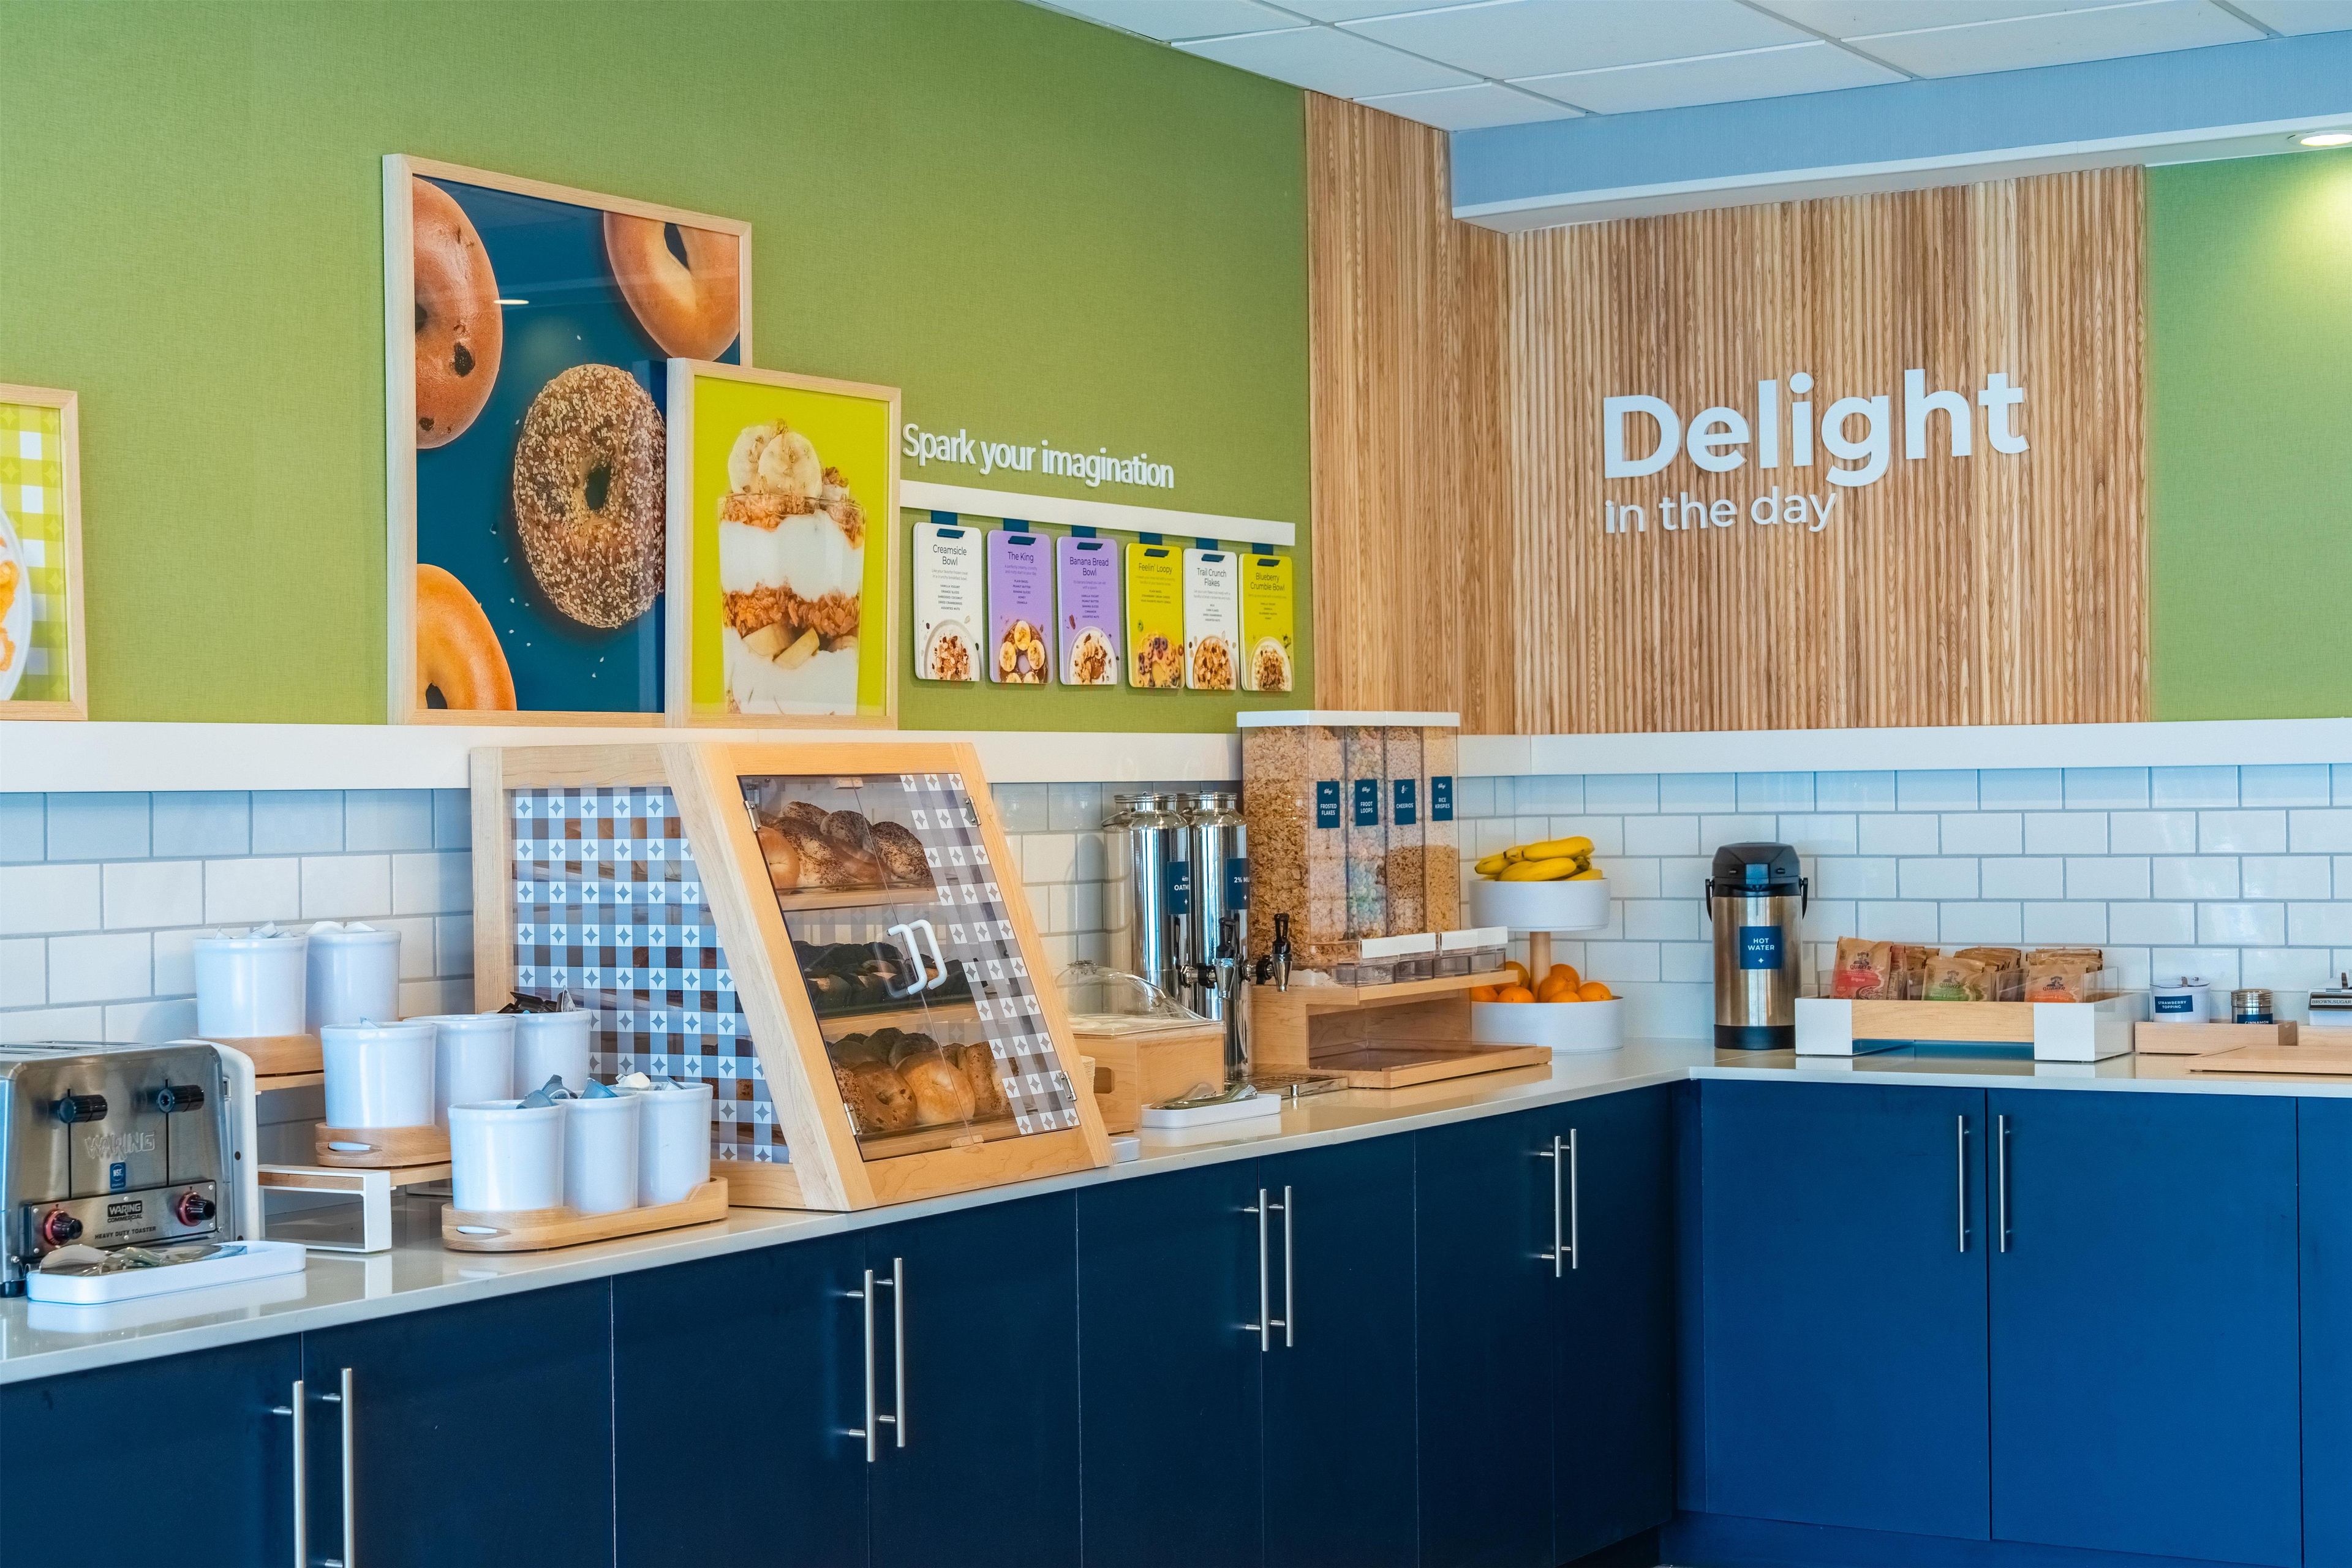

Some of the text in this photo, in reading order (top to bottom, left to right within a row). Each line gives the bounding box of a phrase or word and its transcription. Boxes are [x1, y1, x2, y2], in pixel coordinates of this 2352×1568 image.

[1603, 368, 2030, 488] Delight
[902, 423, 1174, 489] Spark your imagination
[1605, 486, 1836, 534] in the day
[933, 544, 967, 556] Creamsicle
[942, 556, 958, 566] Bowl
[1008, 551, 1034, 564] The King
[1069, 557, 1109, 567] Banana Bread
[1139, 562, 1172, 575] Feelin' Loopy
[1197, 568, 1227, 578] Trail Crunch
[1204, 578, 1220, 587] Flakes
[1256, 572, 1280, 583] Blueberry
[1250, 582, 1285, 592] Crumble Bowl
[85, 1132, 156, 1161] WARING
[108, 1203, 141, 1216] WARING
[107, 1214, 143, 1223] COMMERCIAL
[132, 1226, 156, 1234] TOASTER
